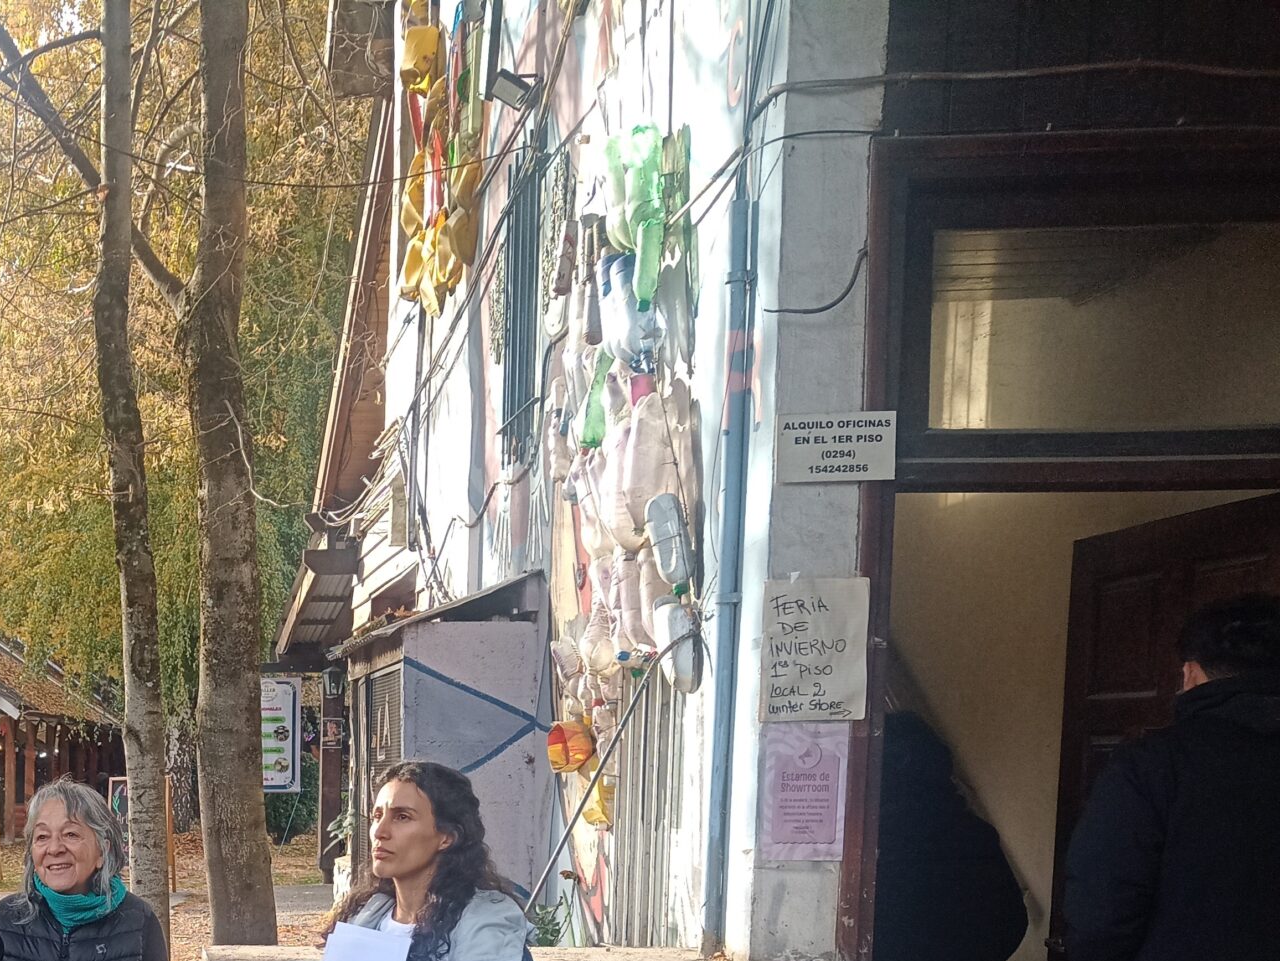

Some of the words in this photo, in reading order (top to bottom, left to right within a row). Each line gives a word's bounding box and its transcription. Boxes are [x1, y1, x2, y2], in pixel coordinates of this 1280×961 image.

[783, 420, 834, 430] ALQUILO
[837, 419, 891, 428] OFICINAS
[794, 436, 810, 445] EN
[814, 435, 828, 444] EL
[831, 435, 853, 443] 1ER
[856, 434, 883, 443] PISO
[821, 450, 856, 460] (0294)
[808, 464, 869, 474] 154242856
[776, 621, 809, 636] DE
[770, 683, 808, 698] LOCAL
[813, 682, 826, 697] 2
[781, 771, 817, 782] Estamos
[820, 771, 830, 781] de
[780, 782, 830, 793] Showrroom
